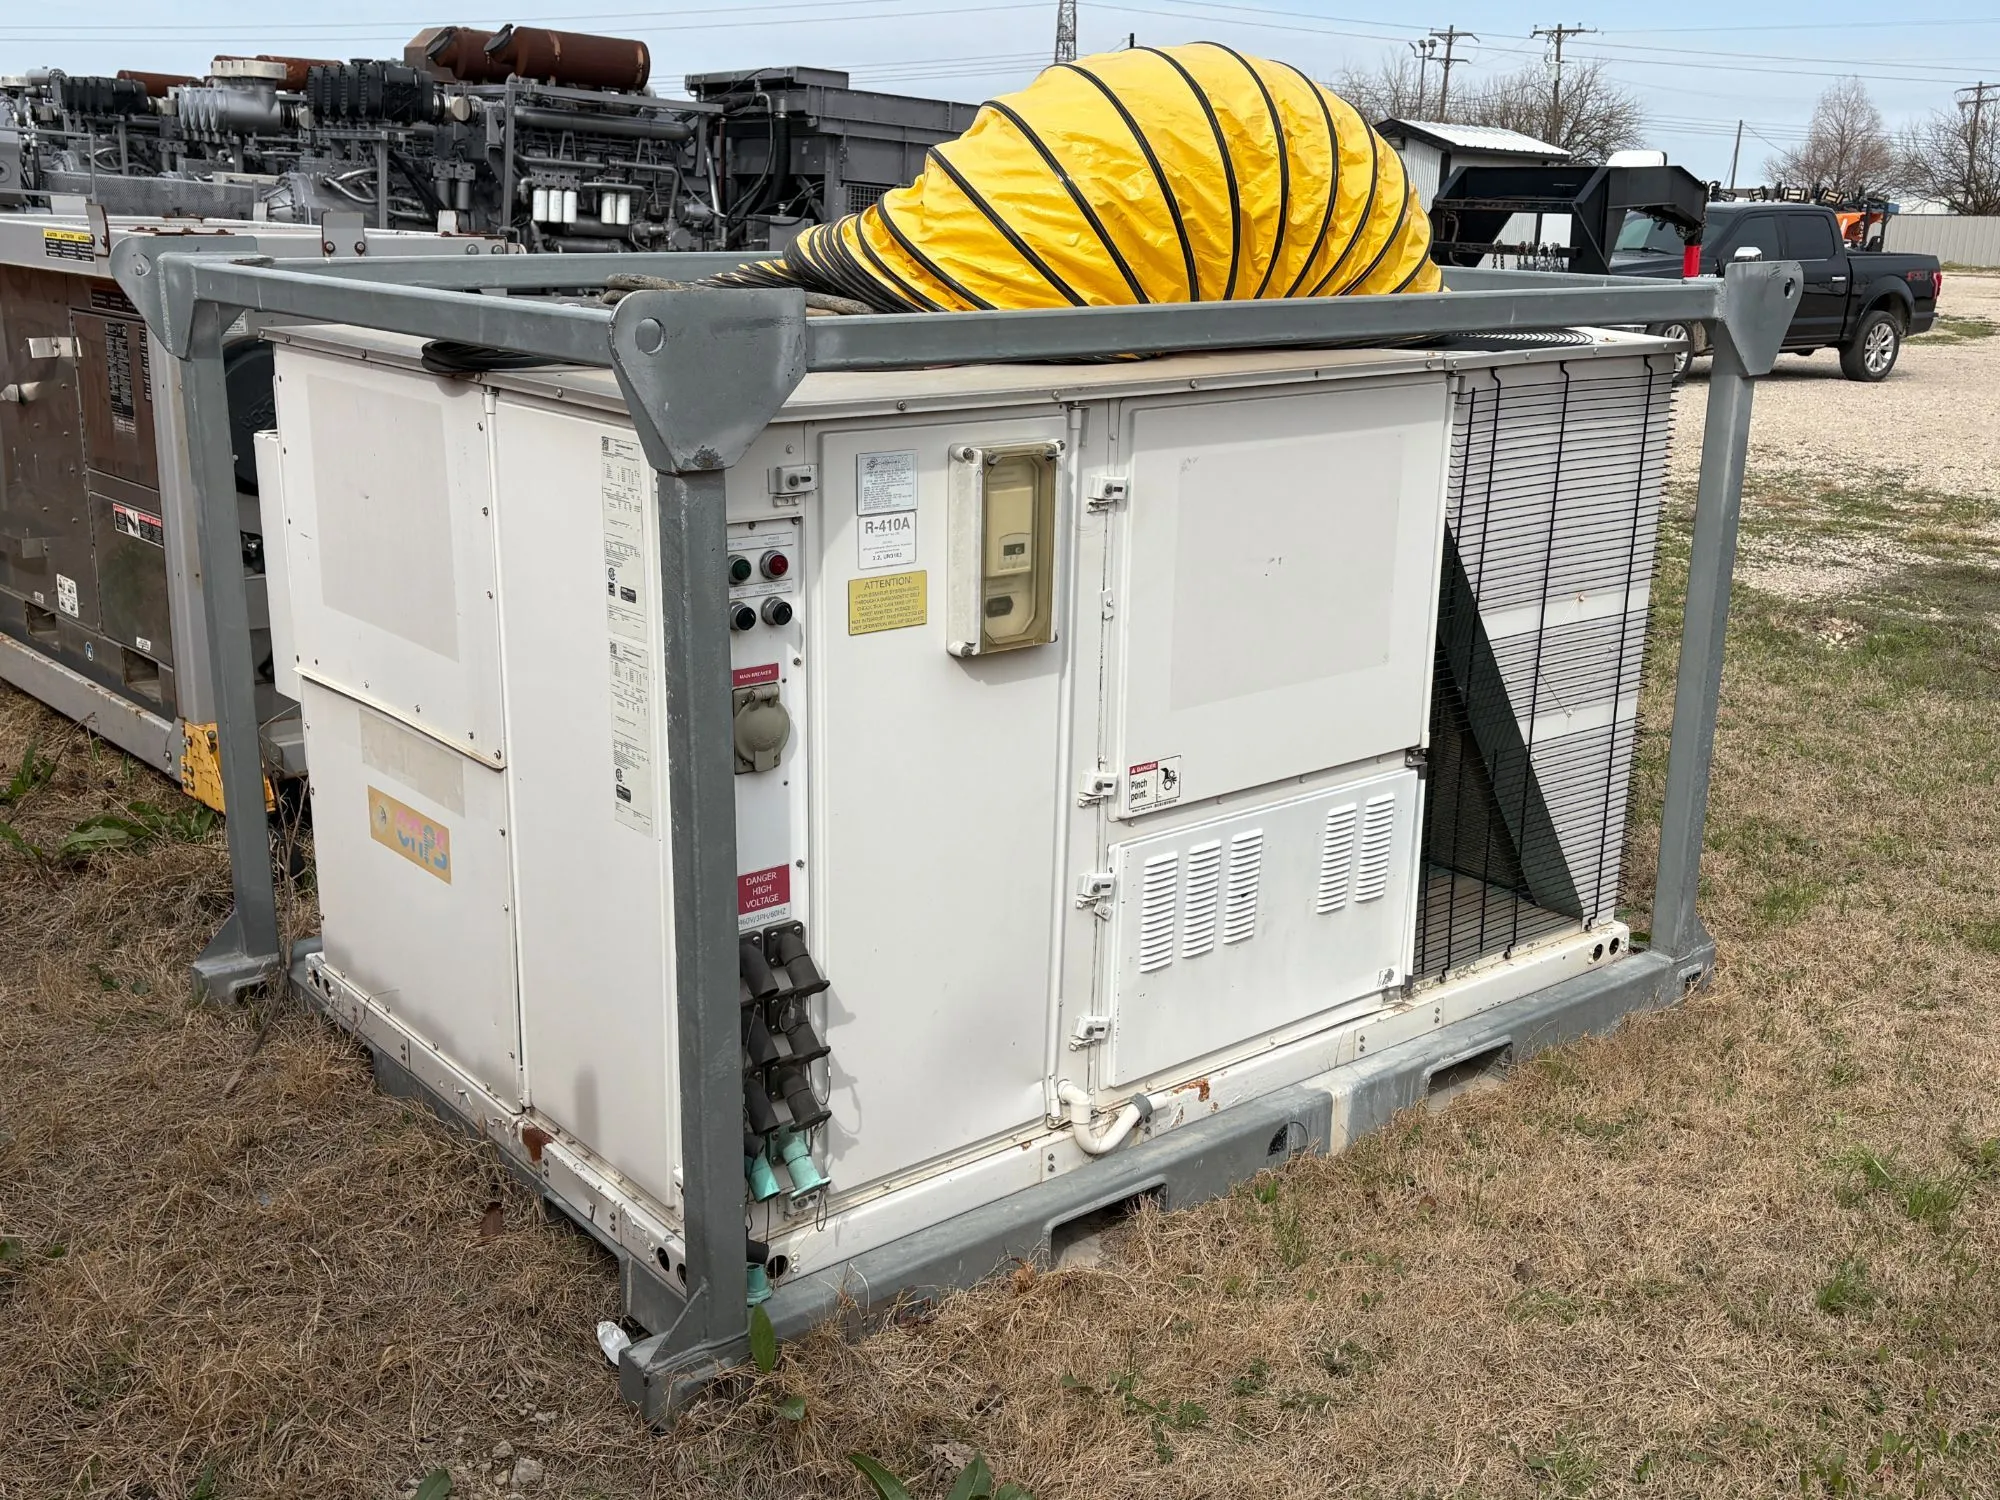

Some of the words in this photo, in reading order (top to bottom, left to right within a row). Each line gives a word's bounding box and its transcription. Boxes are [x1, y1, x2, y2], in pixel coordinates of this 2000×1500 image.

[865, 517, 910, 534] R-410A
[864, 576, 912, 590] ATTENTION:
[751, 670, 772, 678] BREAKER
[1137, 763, 1156, 772] DANGER
[1131, 778, 1147, 790] Pinch
[1131, 790, 1147, 803] point.
[746, 872, 777, 886] DANGER
[752, 885, 772, 896] HIGH
[746, 894, 779, 908] VOLTAGE
